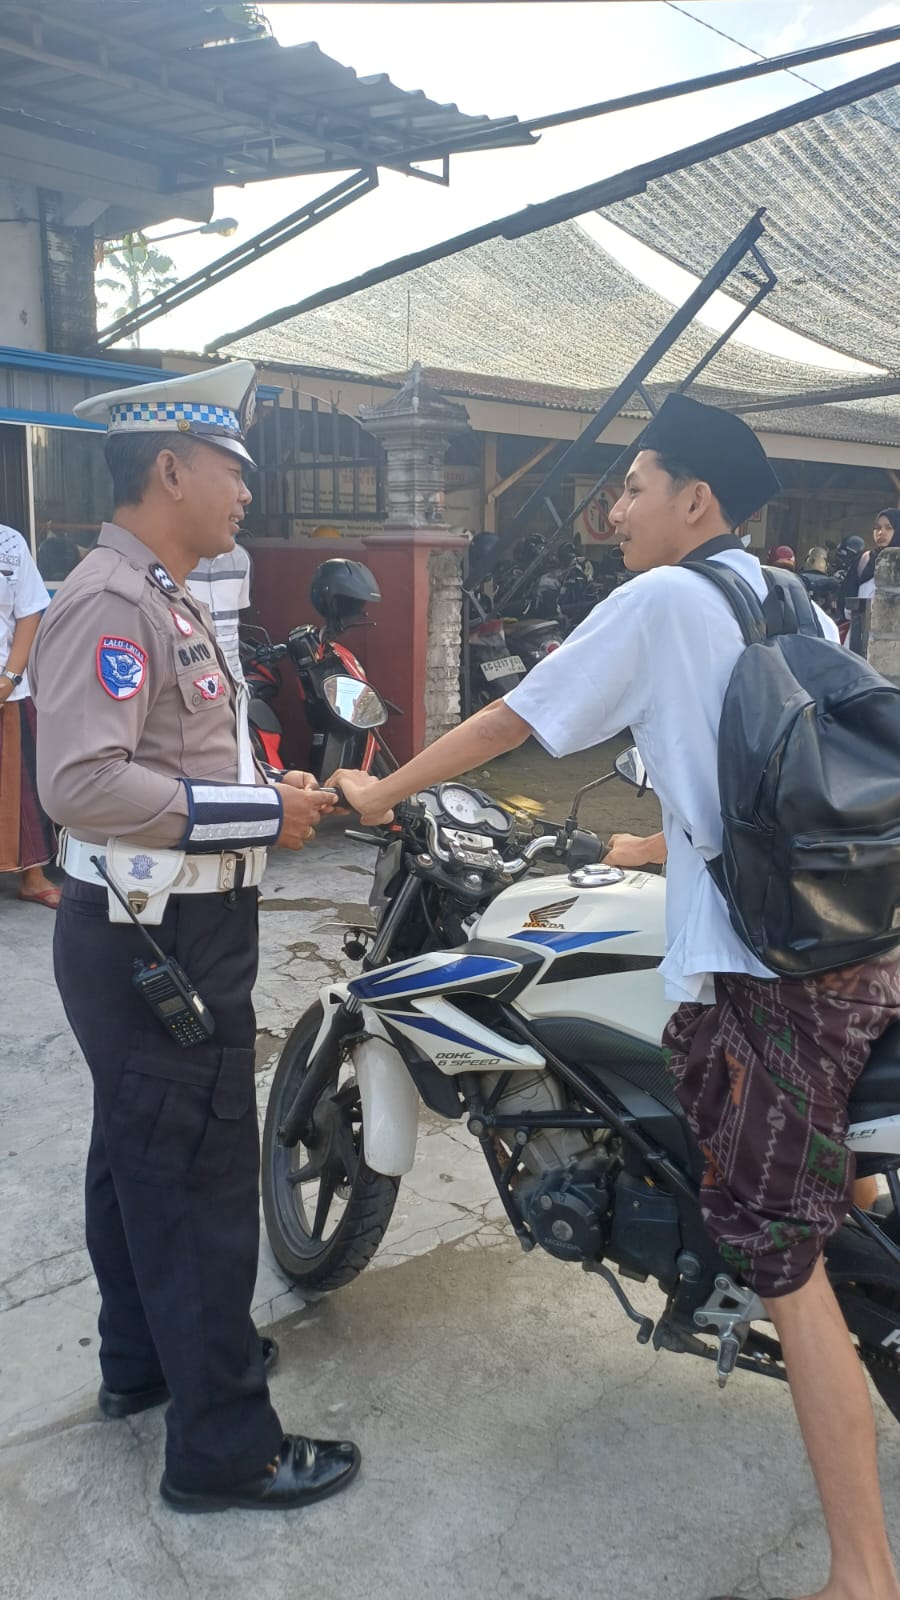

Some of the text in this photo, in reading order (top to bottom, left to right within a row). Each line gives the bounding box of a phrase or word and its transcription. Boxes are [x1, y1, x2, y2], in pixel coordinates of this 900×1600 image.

[104, 639, 123, 648] LALU
[178, 643, 211, 666] BAYU
[522, 922, 566, 930] HONDA
[449, 1058, 501, 1066] SPEED
